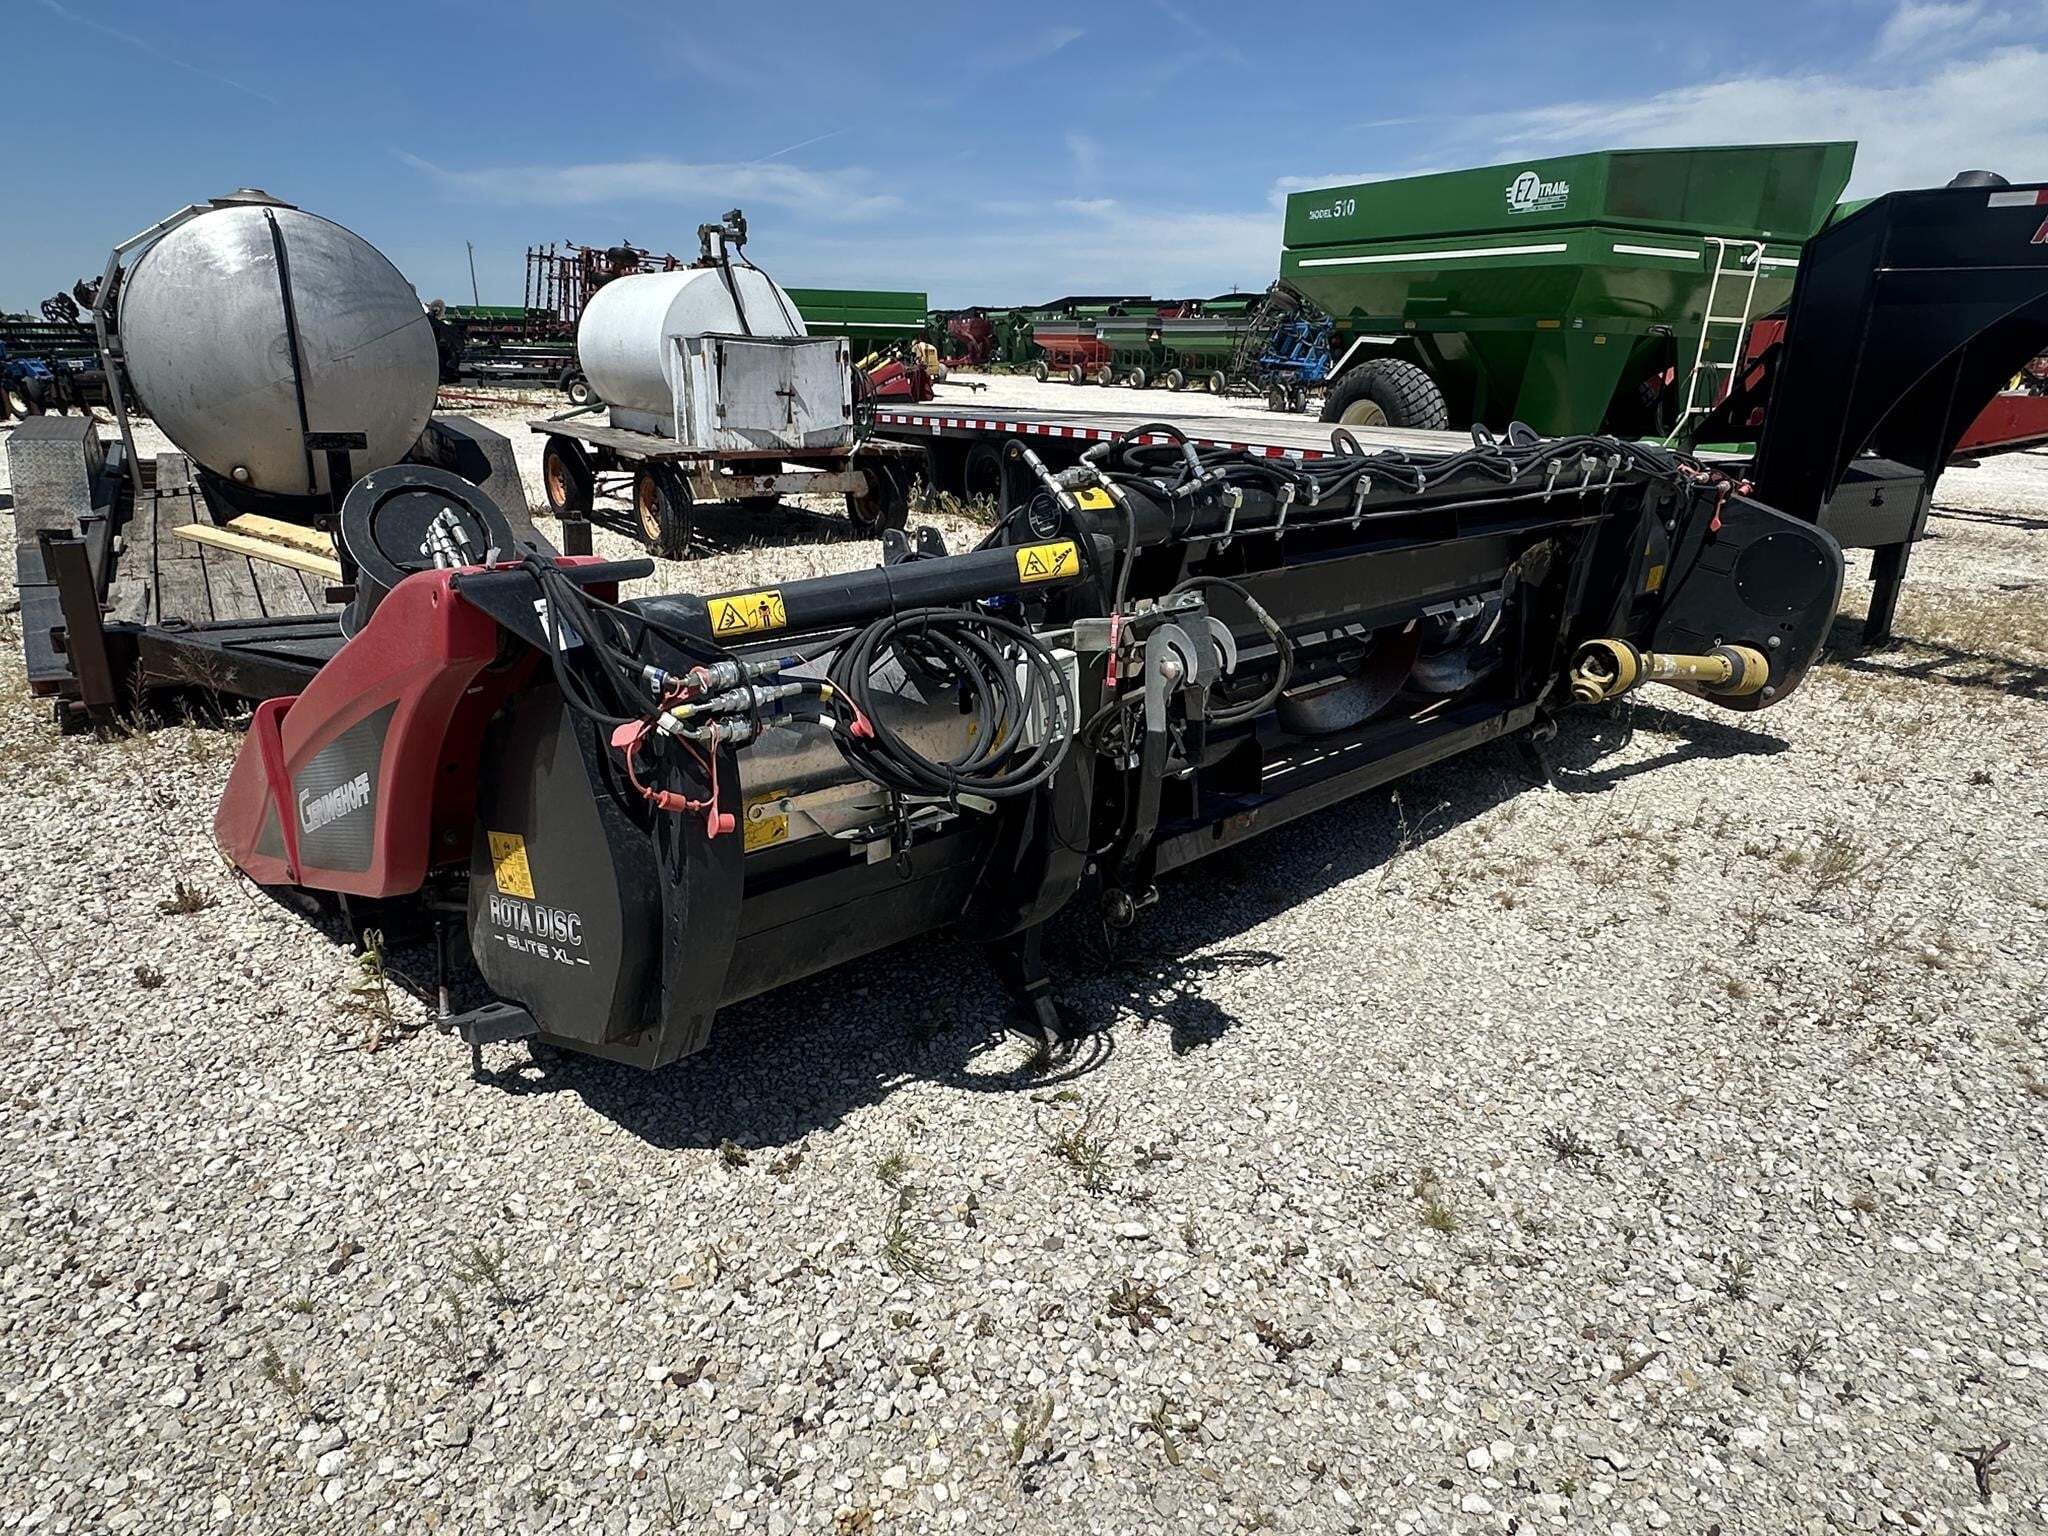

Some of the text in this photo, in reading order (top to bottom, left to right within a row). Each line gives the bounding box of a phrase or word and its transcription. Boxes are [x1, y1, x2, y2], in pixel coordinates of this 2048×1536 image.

[1333, 198, 1356, 218] 510
[489, 894, 582, 946] ROTA DISC
[507, 933, 575, 966] ELITE XL
